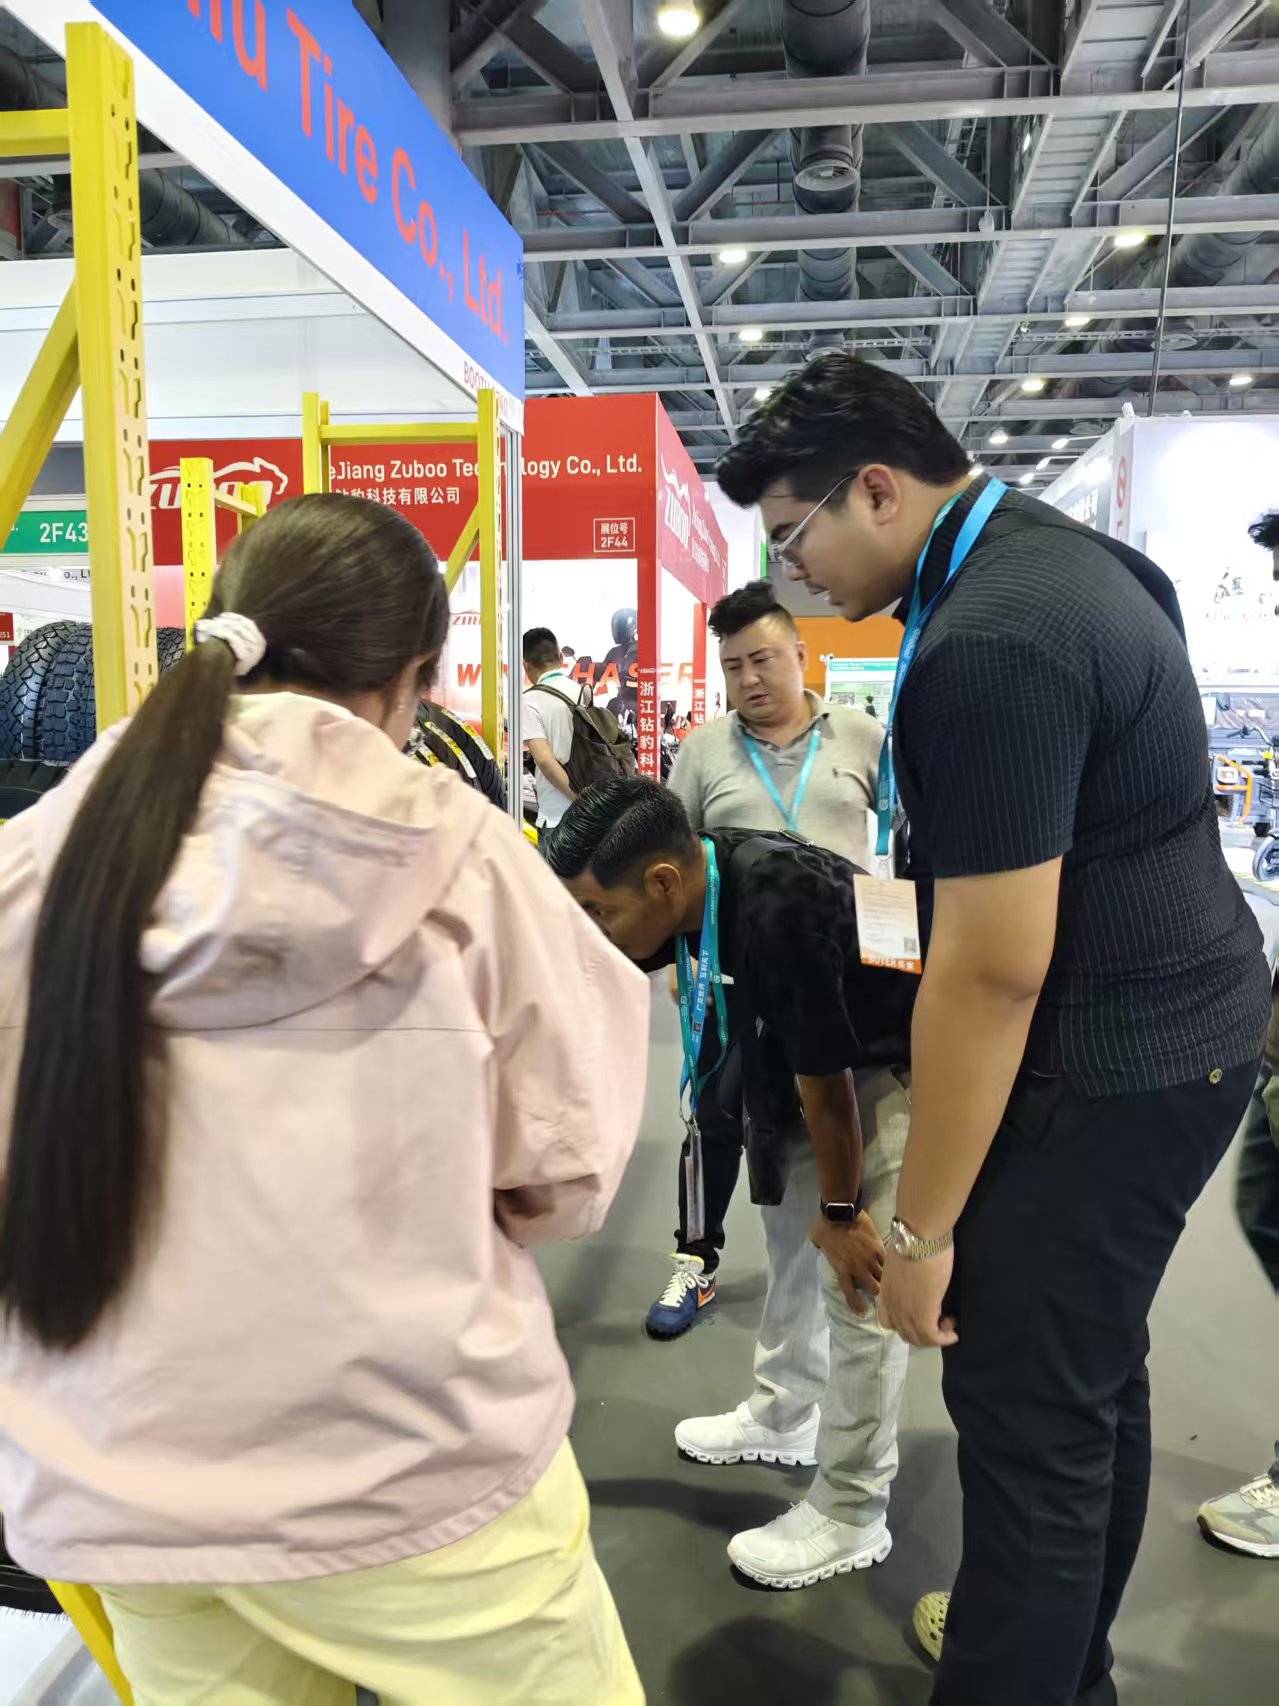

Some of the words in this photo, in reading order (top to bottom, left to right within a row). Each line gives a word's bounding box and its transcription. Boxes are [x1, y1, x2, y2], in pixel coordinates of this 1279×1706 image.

[286, 7, 378, 205] Tire
[391, 147, 454, 304] Co.,
[462, 225, 510, 345] Ltd.
[390, 460, 447, 479] Zuboo
[566, 456, 601, 477] Co.,
[606, 454, 643, 474] Ltd.
[40, 523, 89, 543] 2F43
[600, 523, 628, 535] 展位号
[600, 537, 628, 548] 2F44
